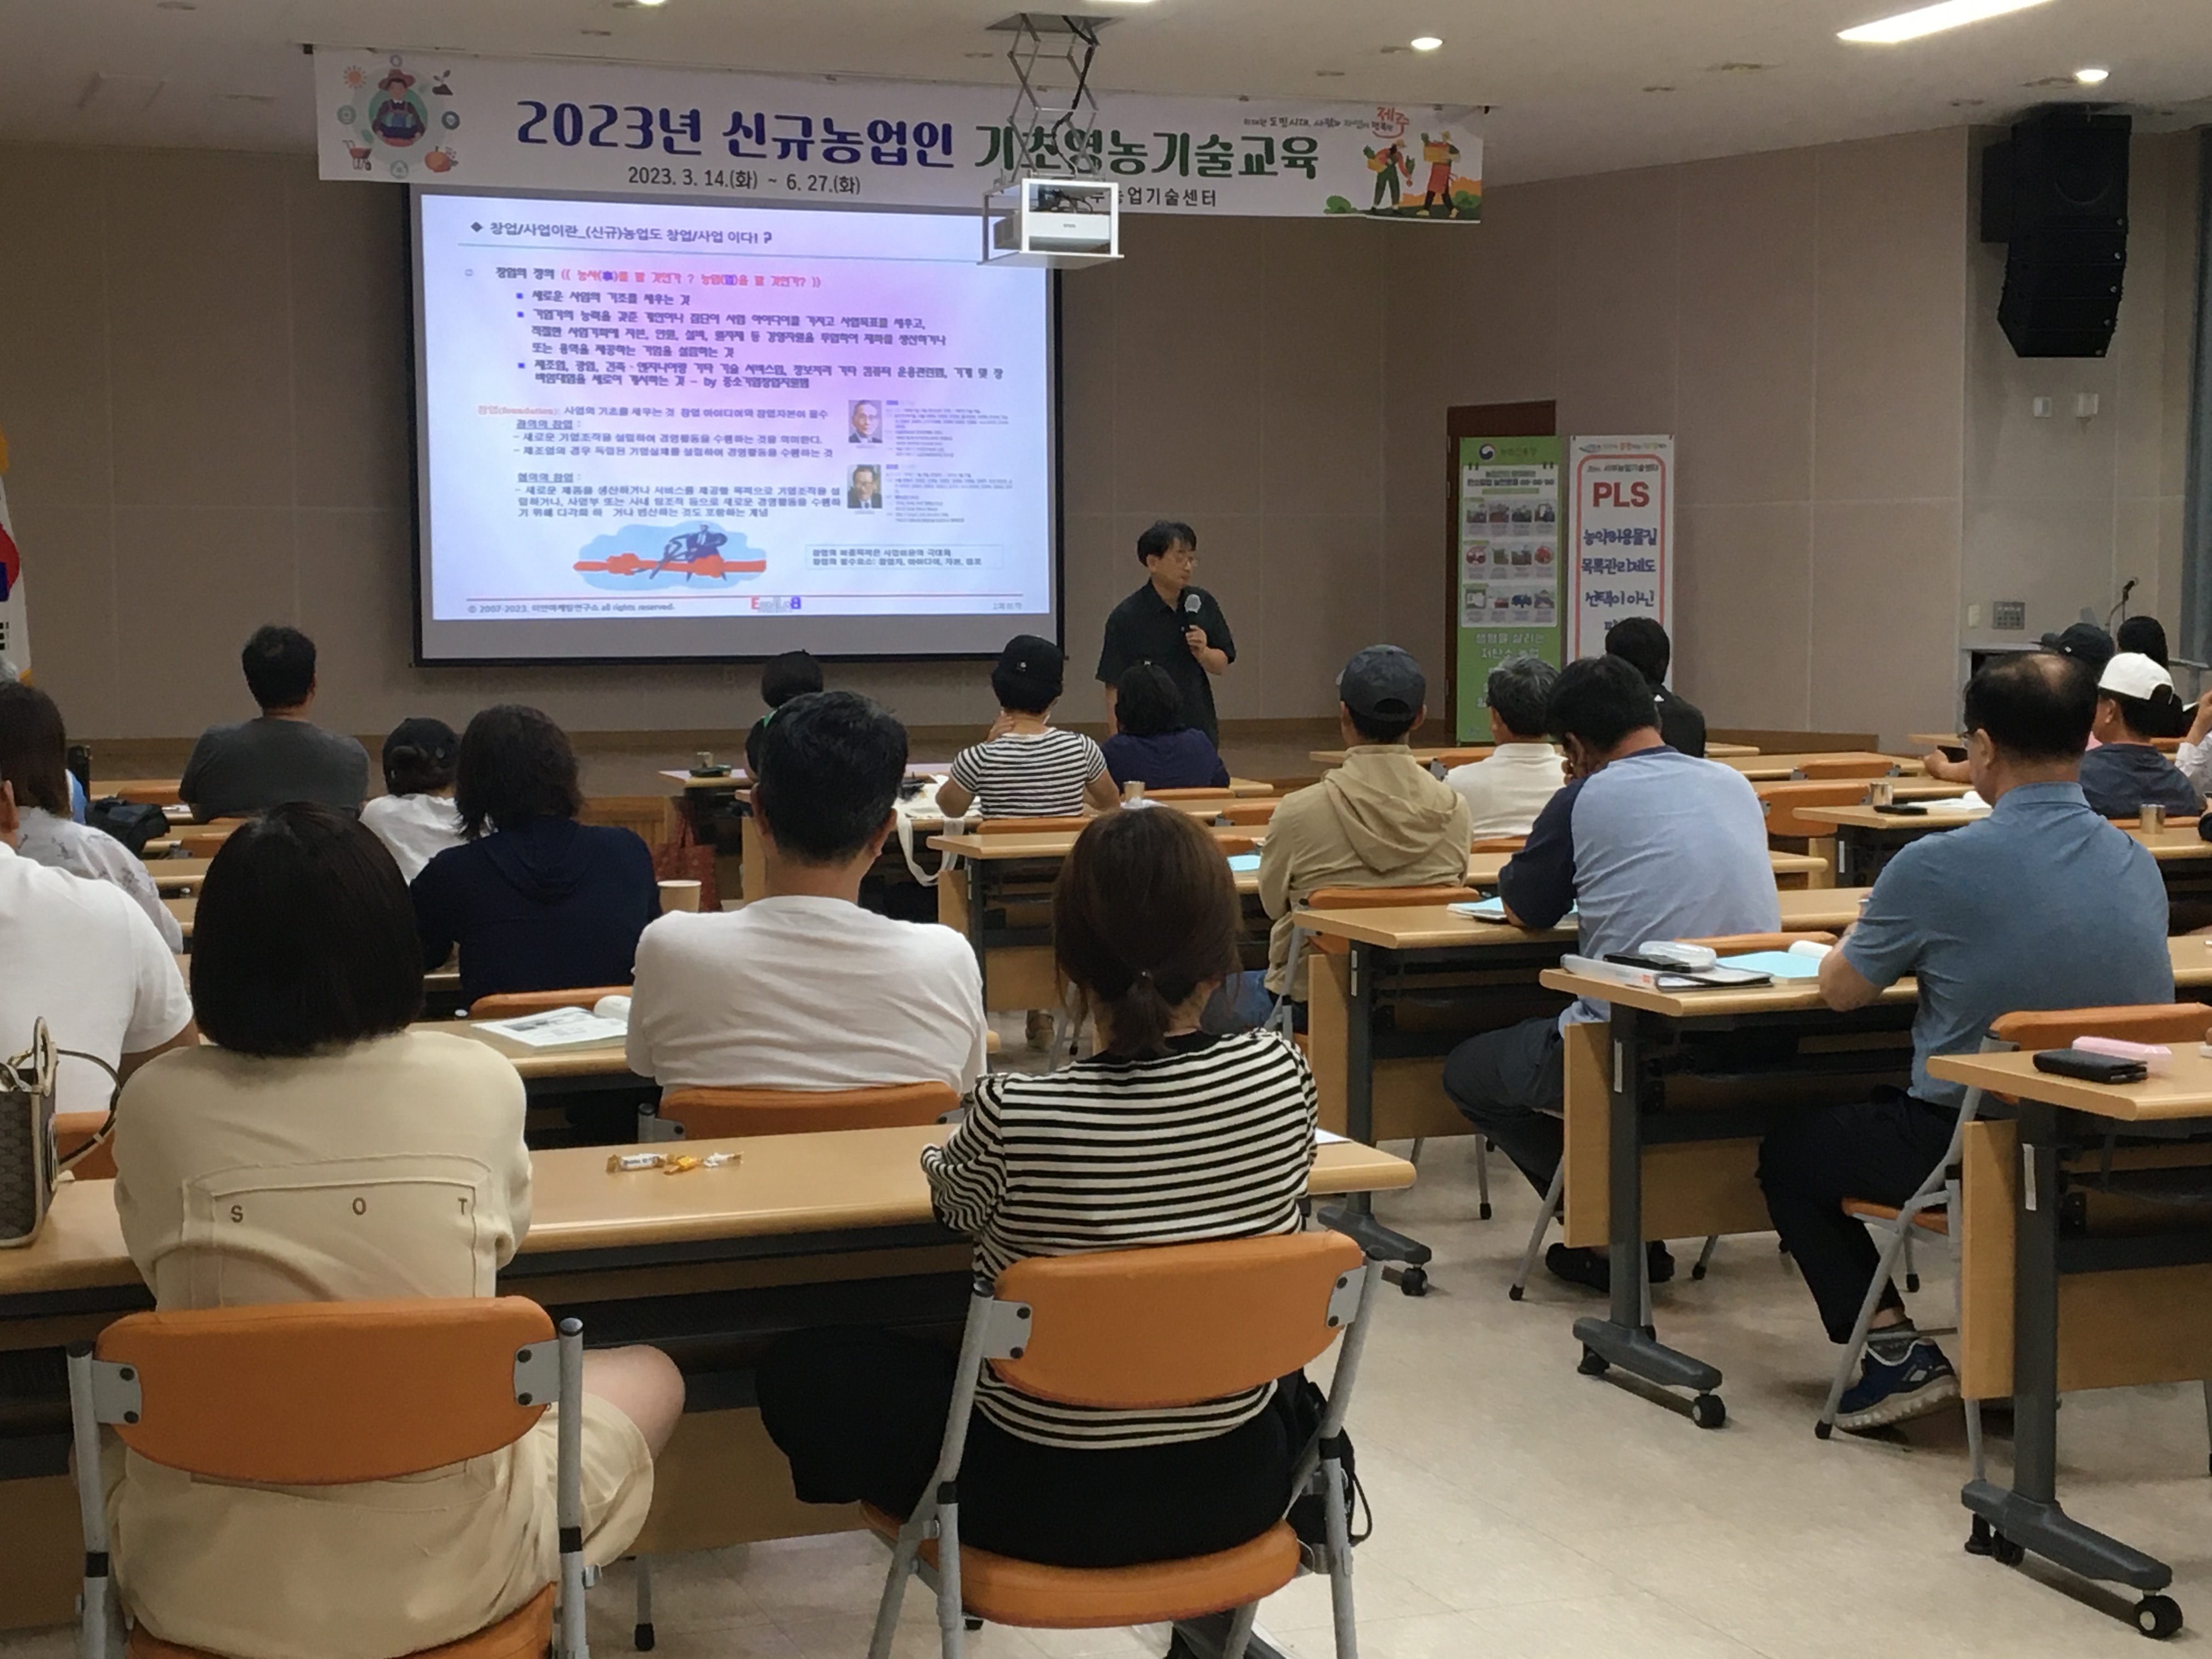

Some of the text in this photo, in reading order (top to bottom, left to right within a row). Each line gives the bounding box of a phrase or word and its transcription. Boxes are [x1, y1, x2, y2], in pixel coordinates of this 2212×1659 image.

[517, 101, 702, 155] 2023년
[722, 110, 955, 169] 신규농업인
[628, 166, 678, 185] 2023.
[683, 168, 699, 186] 3.
[705, 169, 758, 191] 14.(화)
[787, 174, 800, 189] 6.
[807, 173, 861, 195] 27.(화)
[667, 230, 723, 243] 창업/사업
[1593, 481, 1650, 508] PLS
